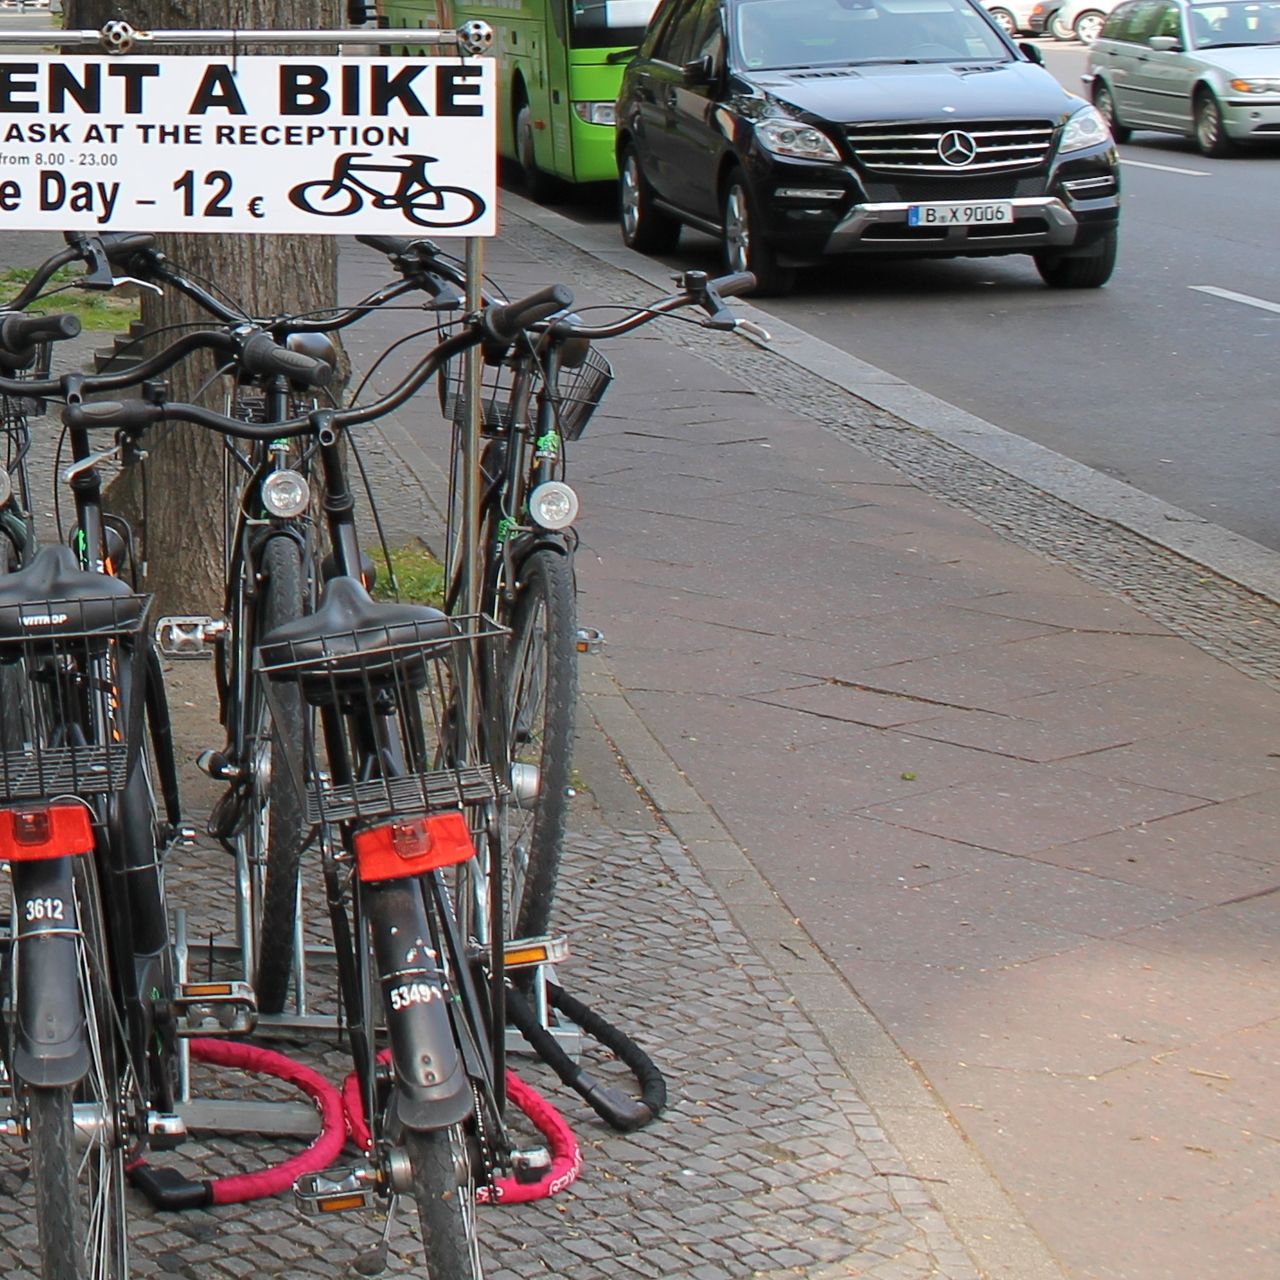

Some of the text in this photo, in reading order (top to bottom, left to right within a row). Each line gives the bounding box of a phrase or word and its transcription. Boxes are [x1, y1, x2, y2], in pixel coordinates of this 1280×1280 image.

[187, 63, 248, 116] A
[279, 64, 485, 118] BIKE
[3, 123, 411, 147] ASK AT THE RECEPTION
[34, 152, 66, 166] 8.00
[78, 153, 119, 167] 23.00
[39, 169, 121, 224] Day
[172, 169, 235, 218] 12
[247, 196, 265, 219] €
[926, 205, 1005, 222] B X 9006
[26, 897, 65, 921] 3612
